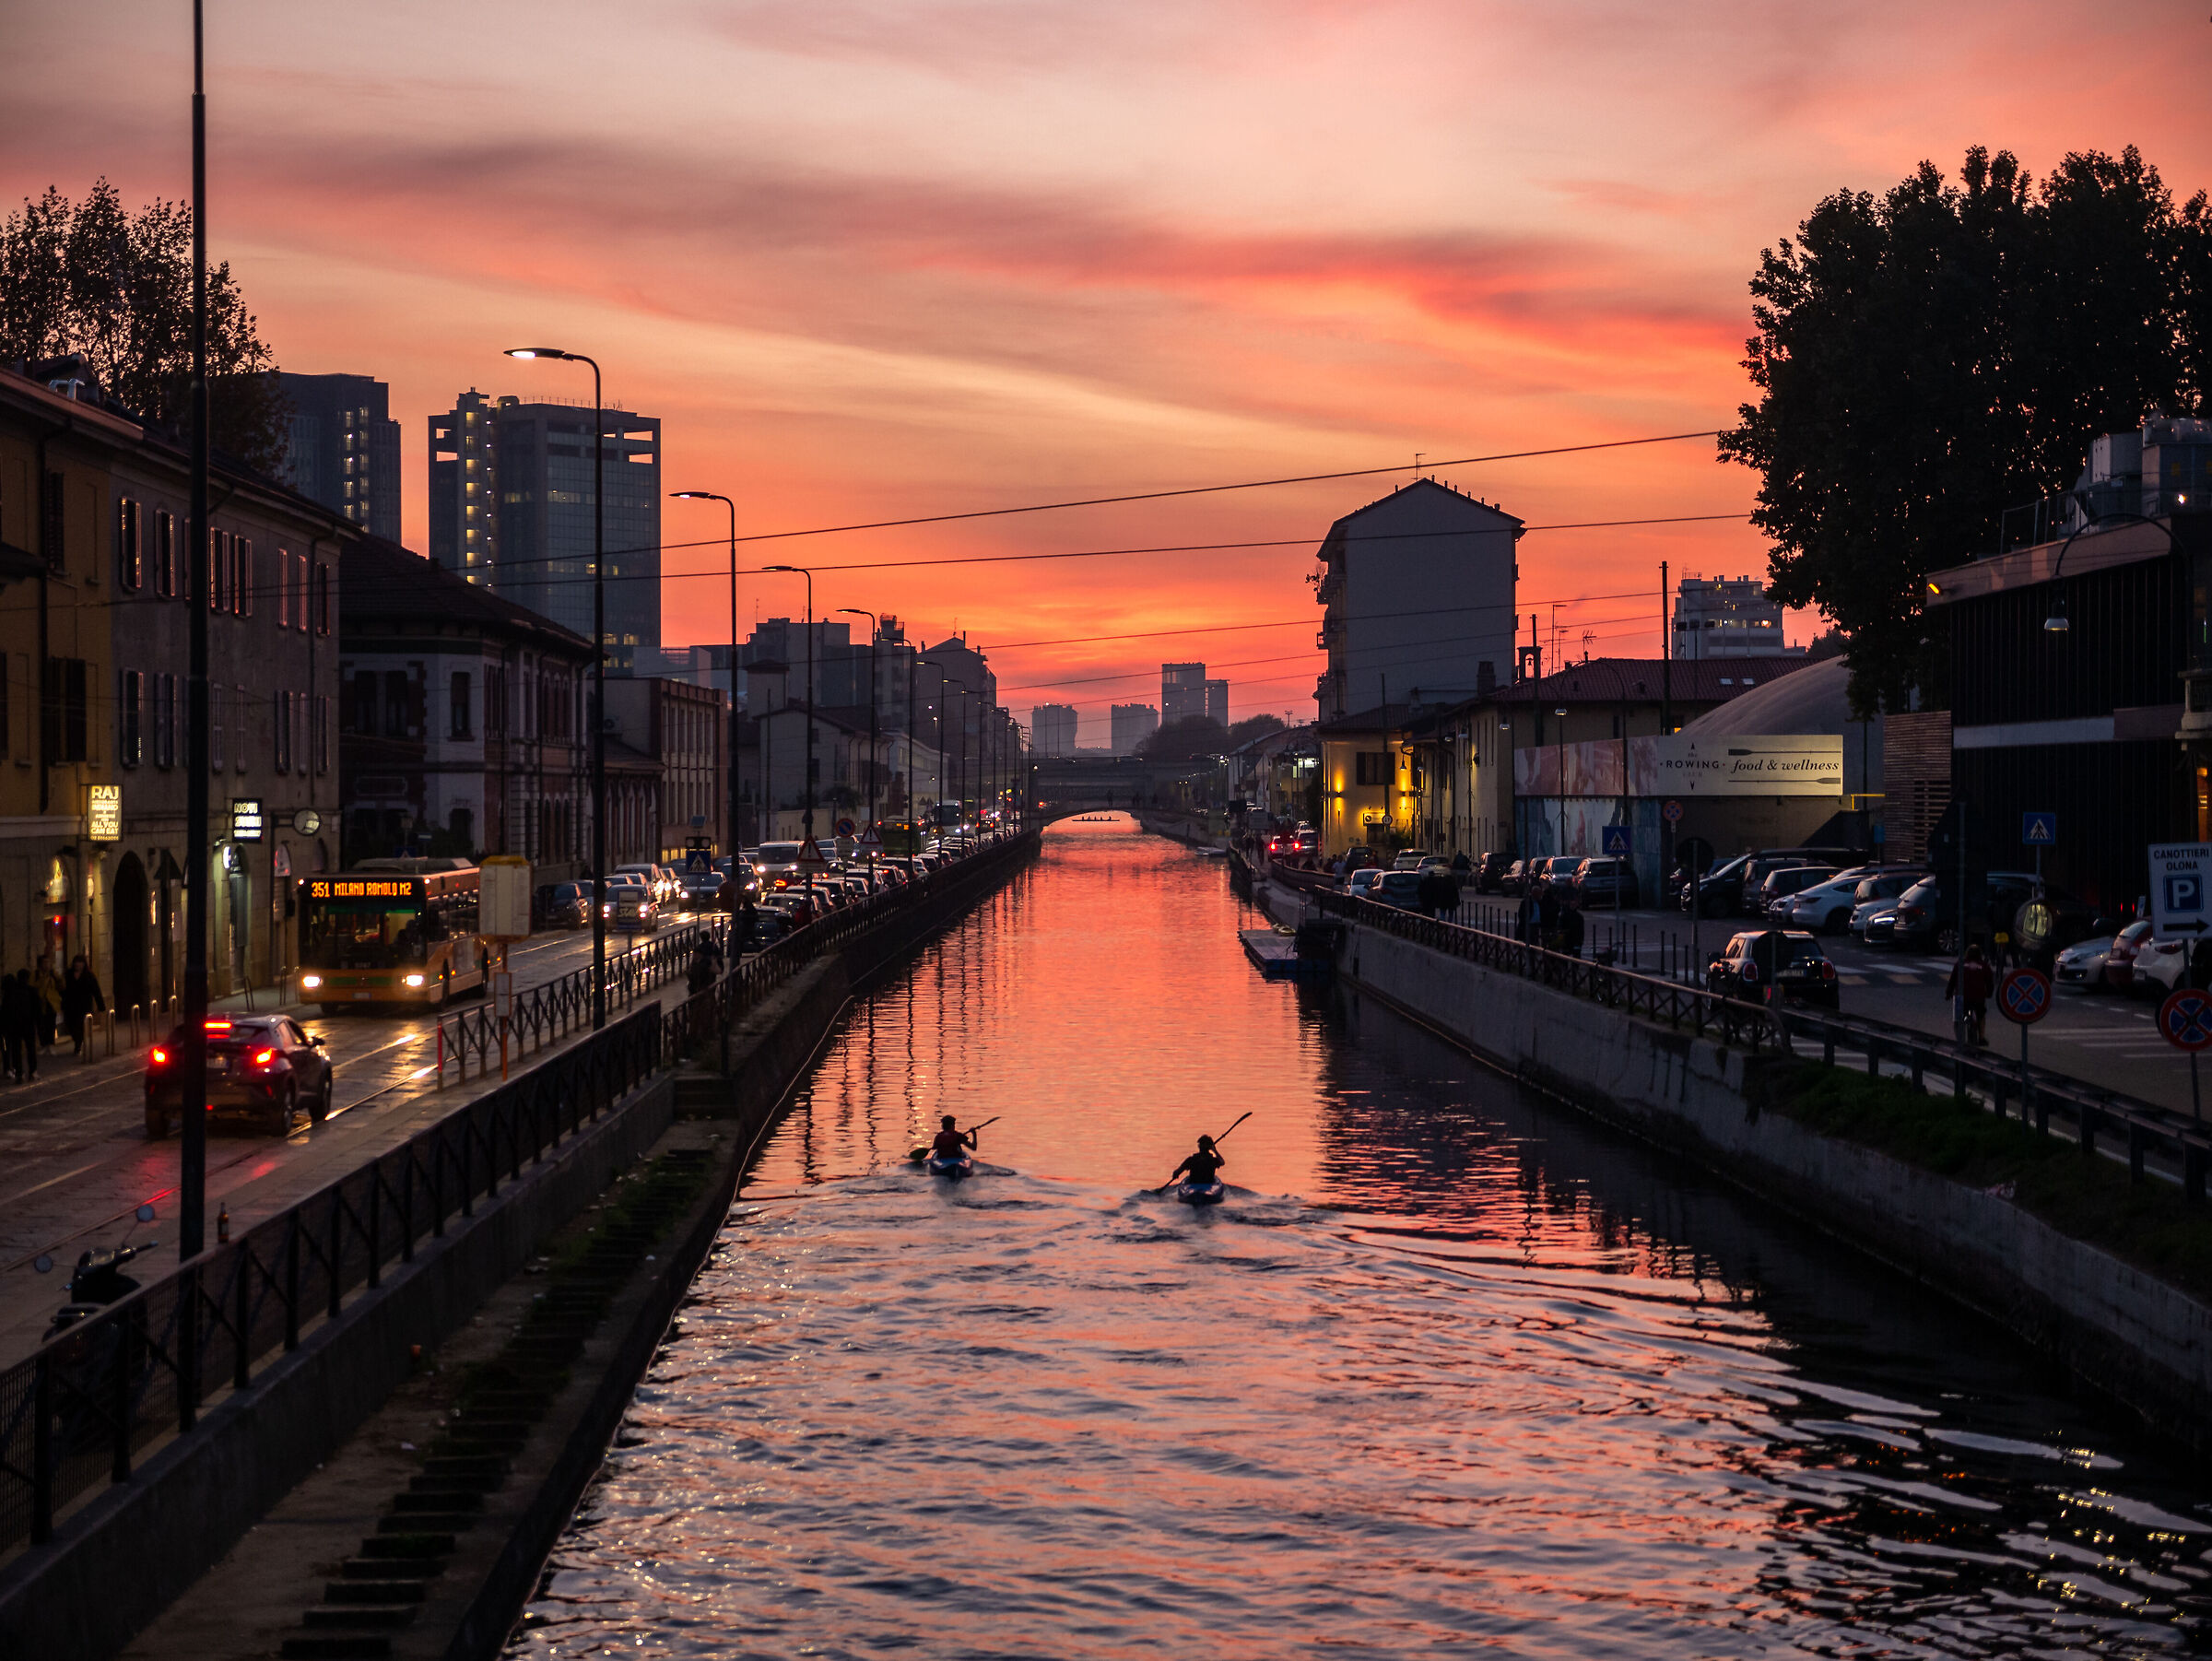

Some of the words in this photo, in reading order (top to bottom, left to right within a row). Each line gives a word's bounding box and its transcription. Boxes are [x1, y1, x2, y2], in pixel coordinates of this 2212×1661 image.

[1666, 760, 1719, 769] ROWING
[1729, 760, 1763, 773] food
[1767, 760, 1777, 771] &
[1781, 760, 1839, 771] wellness
[91, 786, 119, 799] RAJ
[2154, 848, 2209, 859] CANOTTIERI
[2167, 861, 2198, 871] OLONA
[312, 882, 330, 897] 351
[335, 882, 365, 896] MILANO
[367, 882, 397, 896] ROMOLO
[399, 882, 412, 896] M2
[2172, 878, 2195, 909] P
